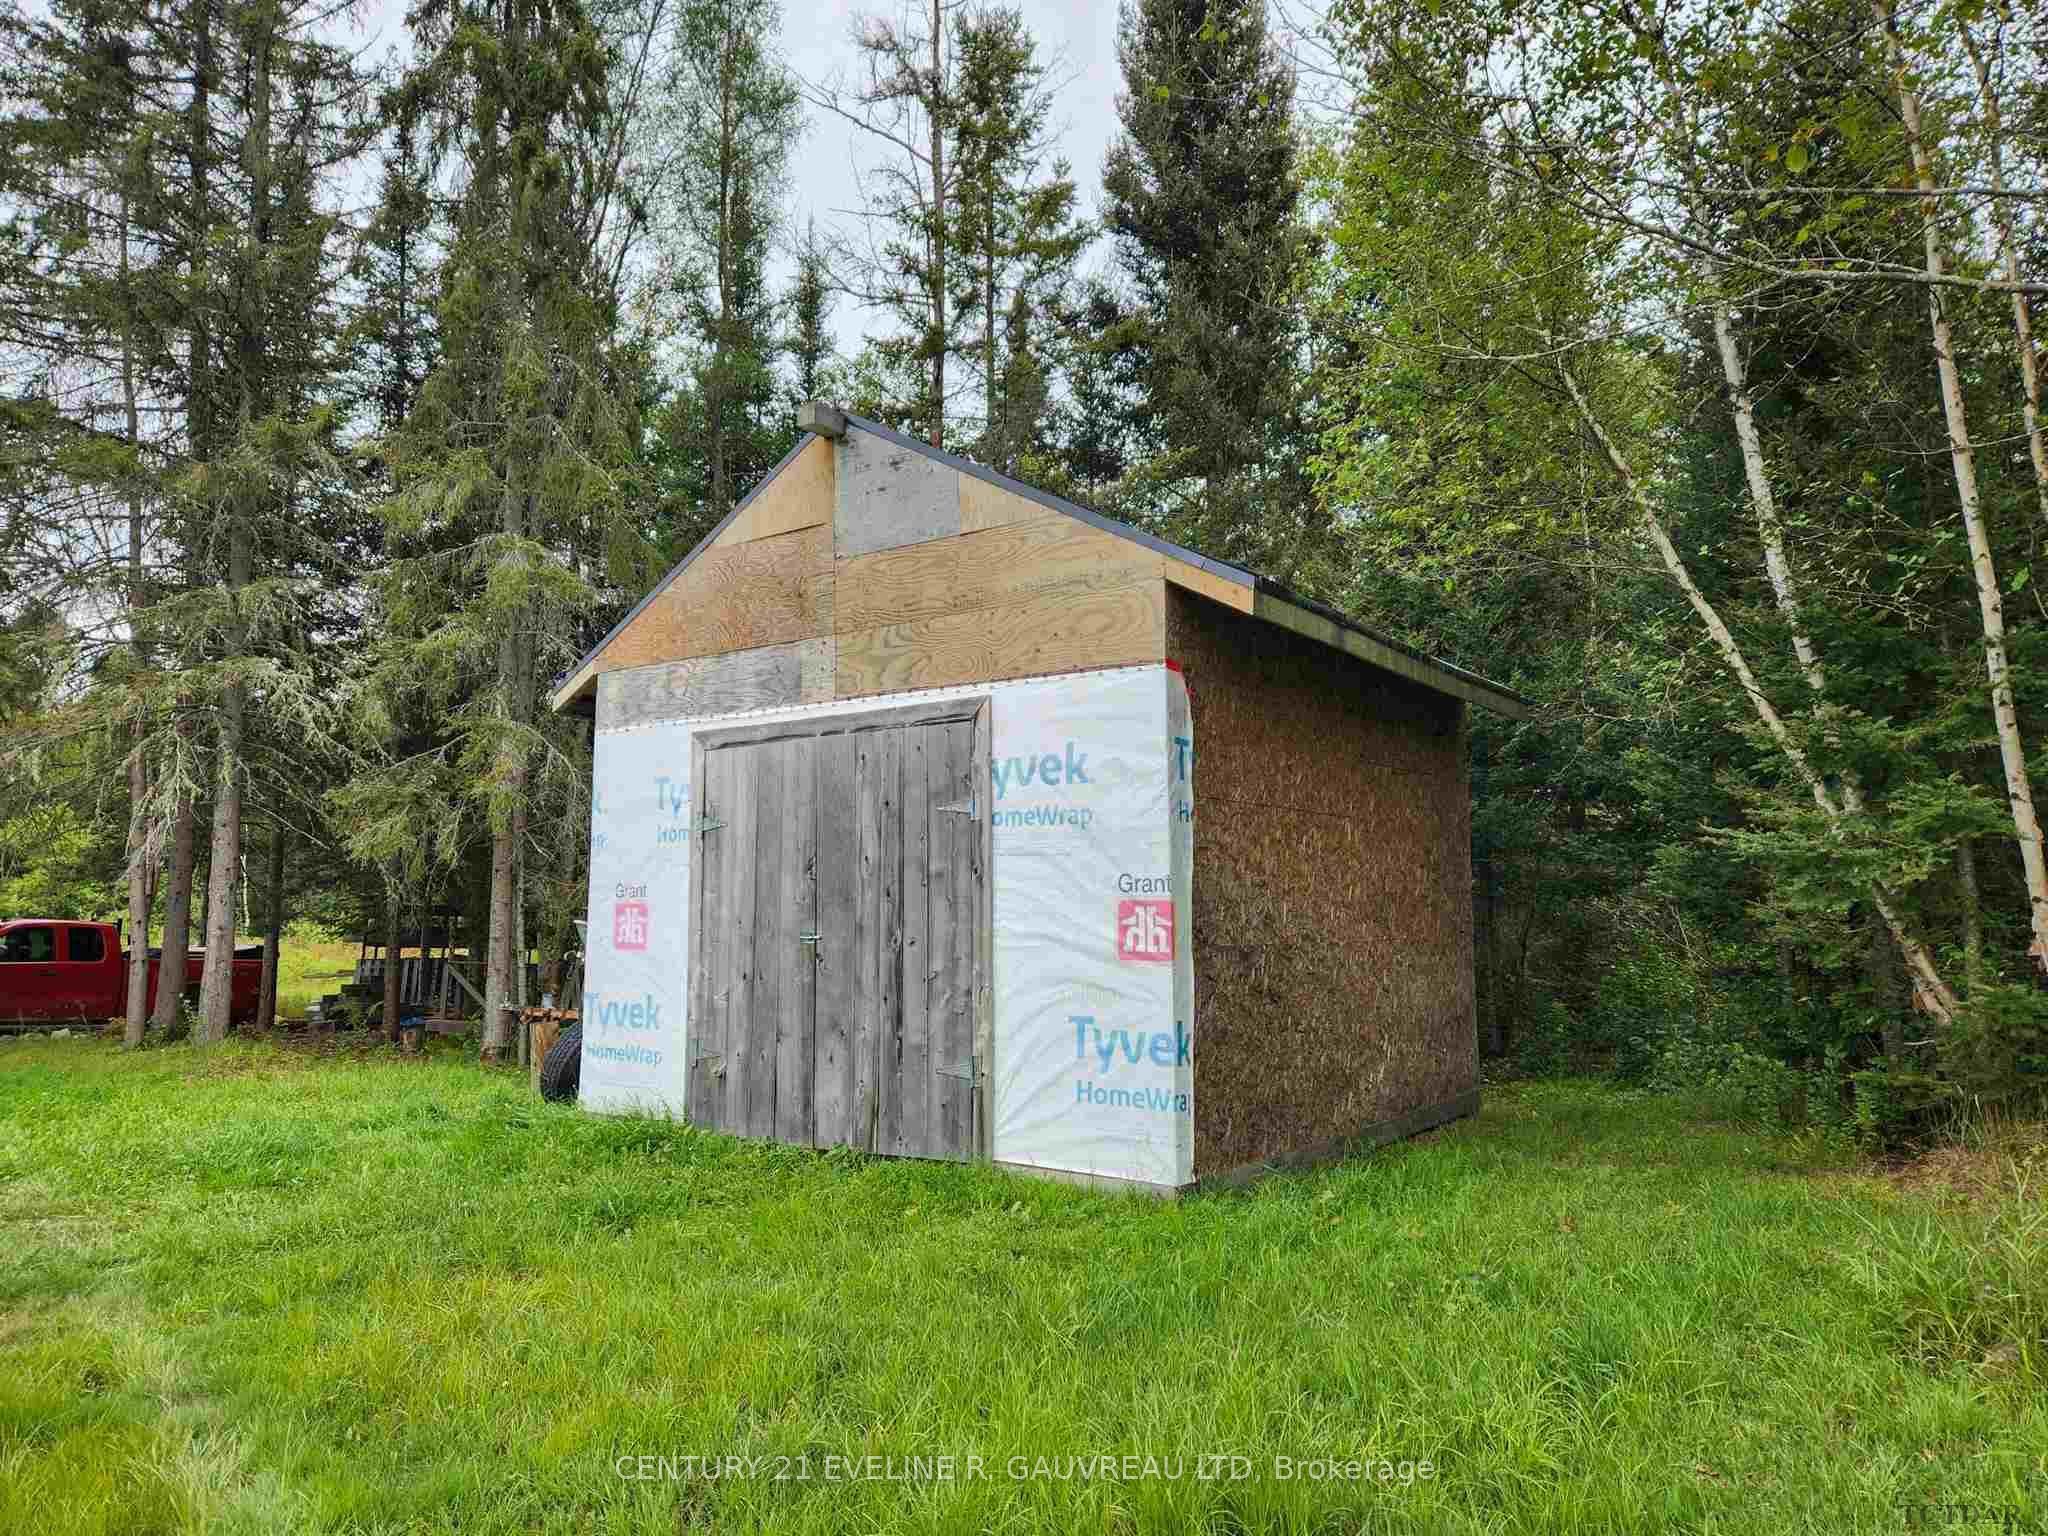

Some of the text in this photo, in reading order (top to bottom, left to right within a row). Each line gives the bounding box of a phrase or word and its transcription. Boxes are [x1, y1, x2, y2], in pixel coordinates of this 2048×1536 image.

[615, 881, 649, 899] Grant
[1118, 873, 1173, 893] Grant
[583, 992, 660, 1036] Tyvek
[584, 1040, 663, 1067] HomeWrap
[1068, 1016, 1191, 1075] Tyvek
